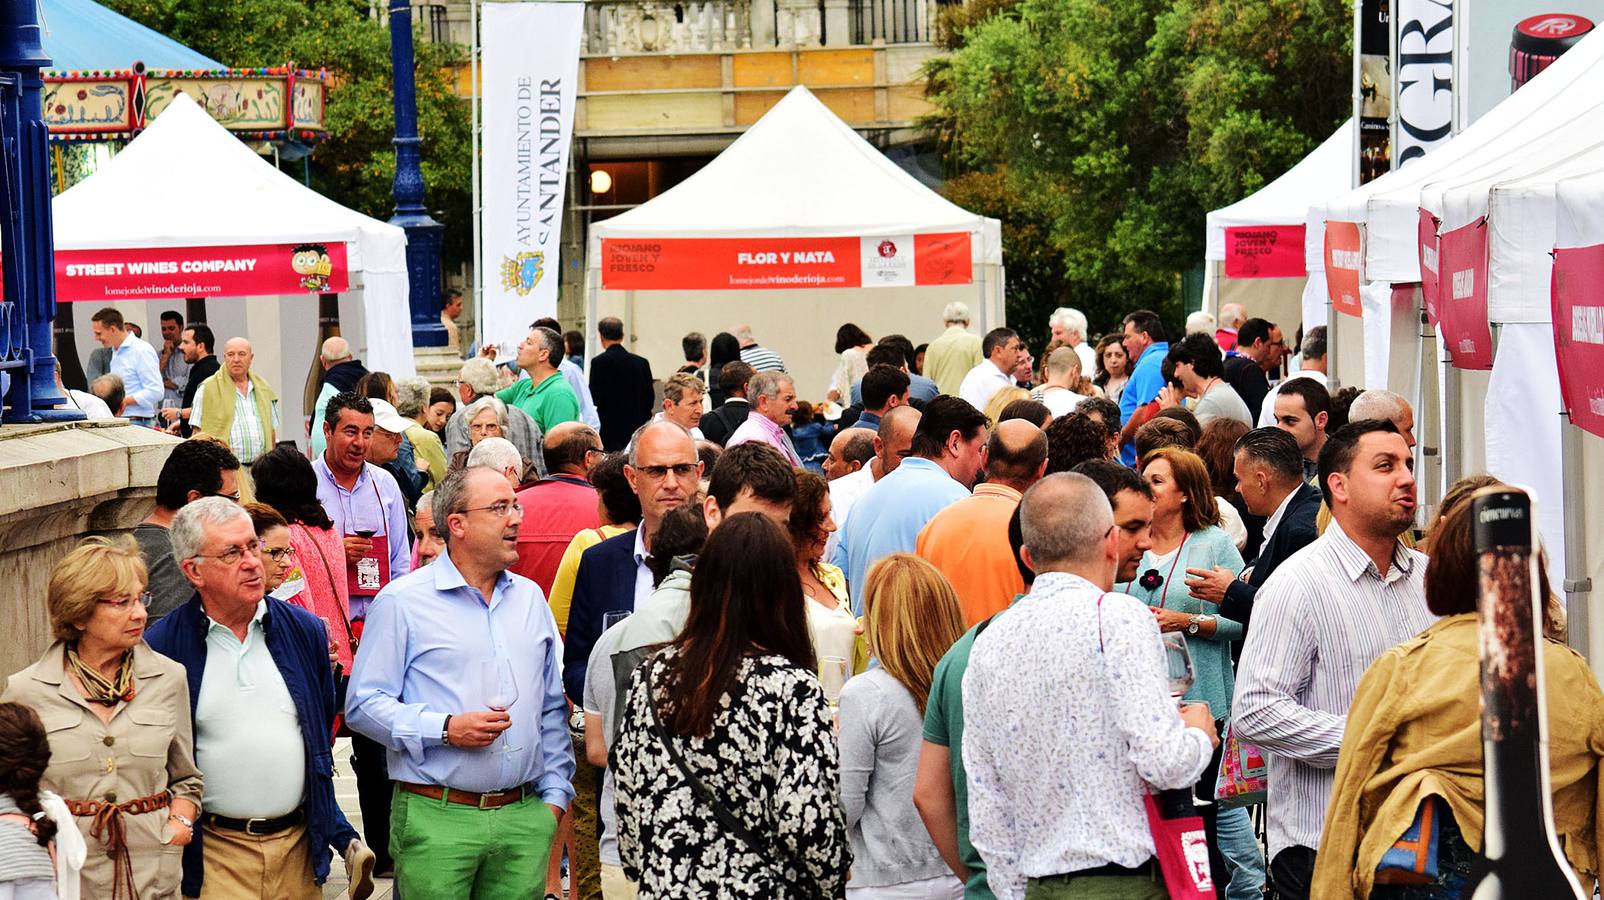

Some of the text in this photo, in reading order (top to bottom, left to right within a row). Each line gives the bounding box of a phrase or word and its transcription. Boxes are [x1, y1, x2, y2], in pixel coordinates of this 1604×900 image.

[1399, 0, 1452, 168] GR
[517, 76, 532, 246] AYUNTAMIENTO DE
[737, 251, 836, 265] FLOR Y NATA
[66, 259, 257, 277] STREET WINES COMPANY
[610, 264, 655, 272] FRESCO
[104, 283, 222, 297] lomejordelvinoderioja.com
